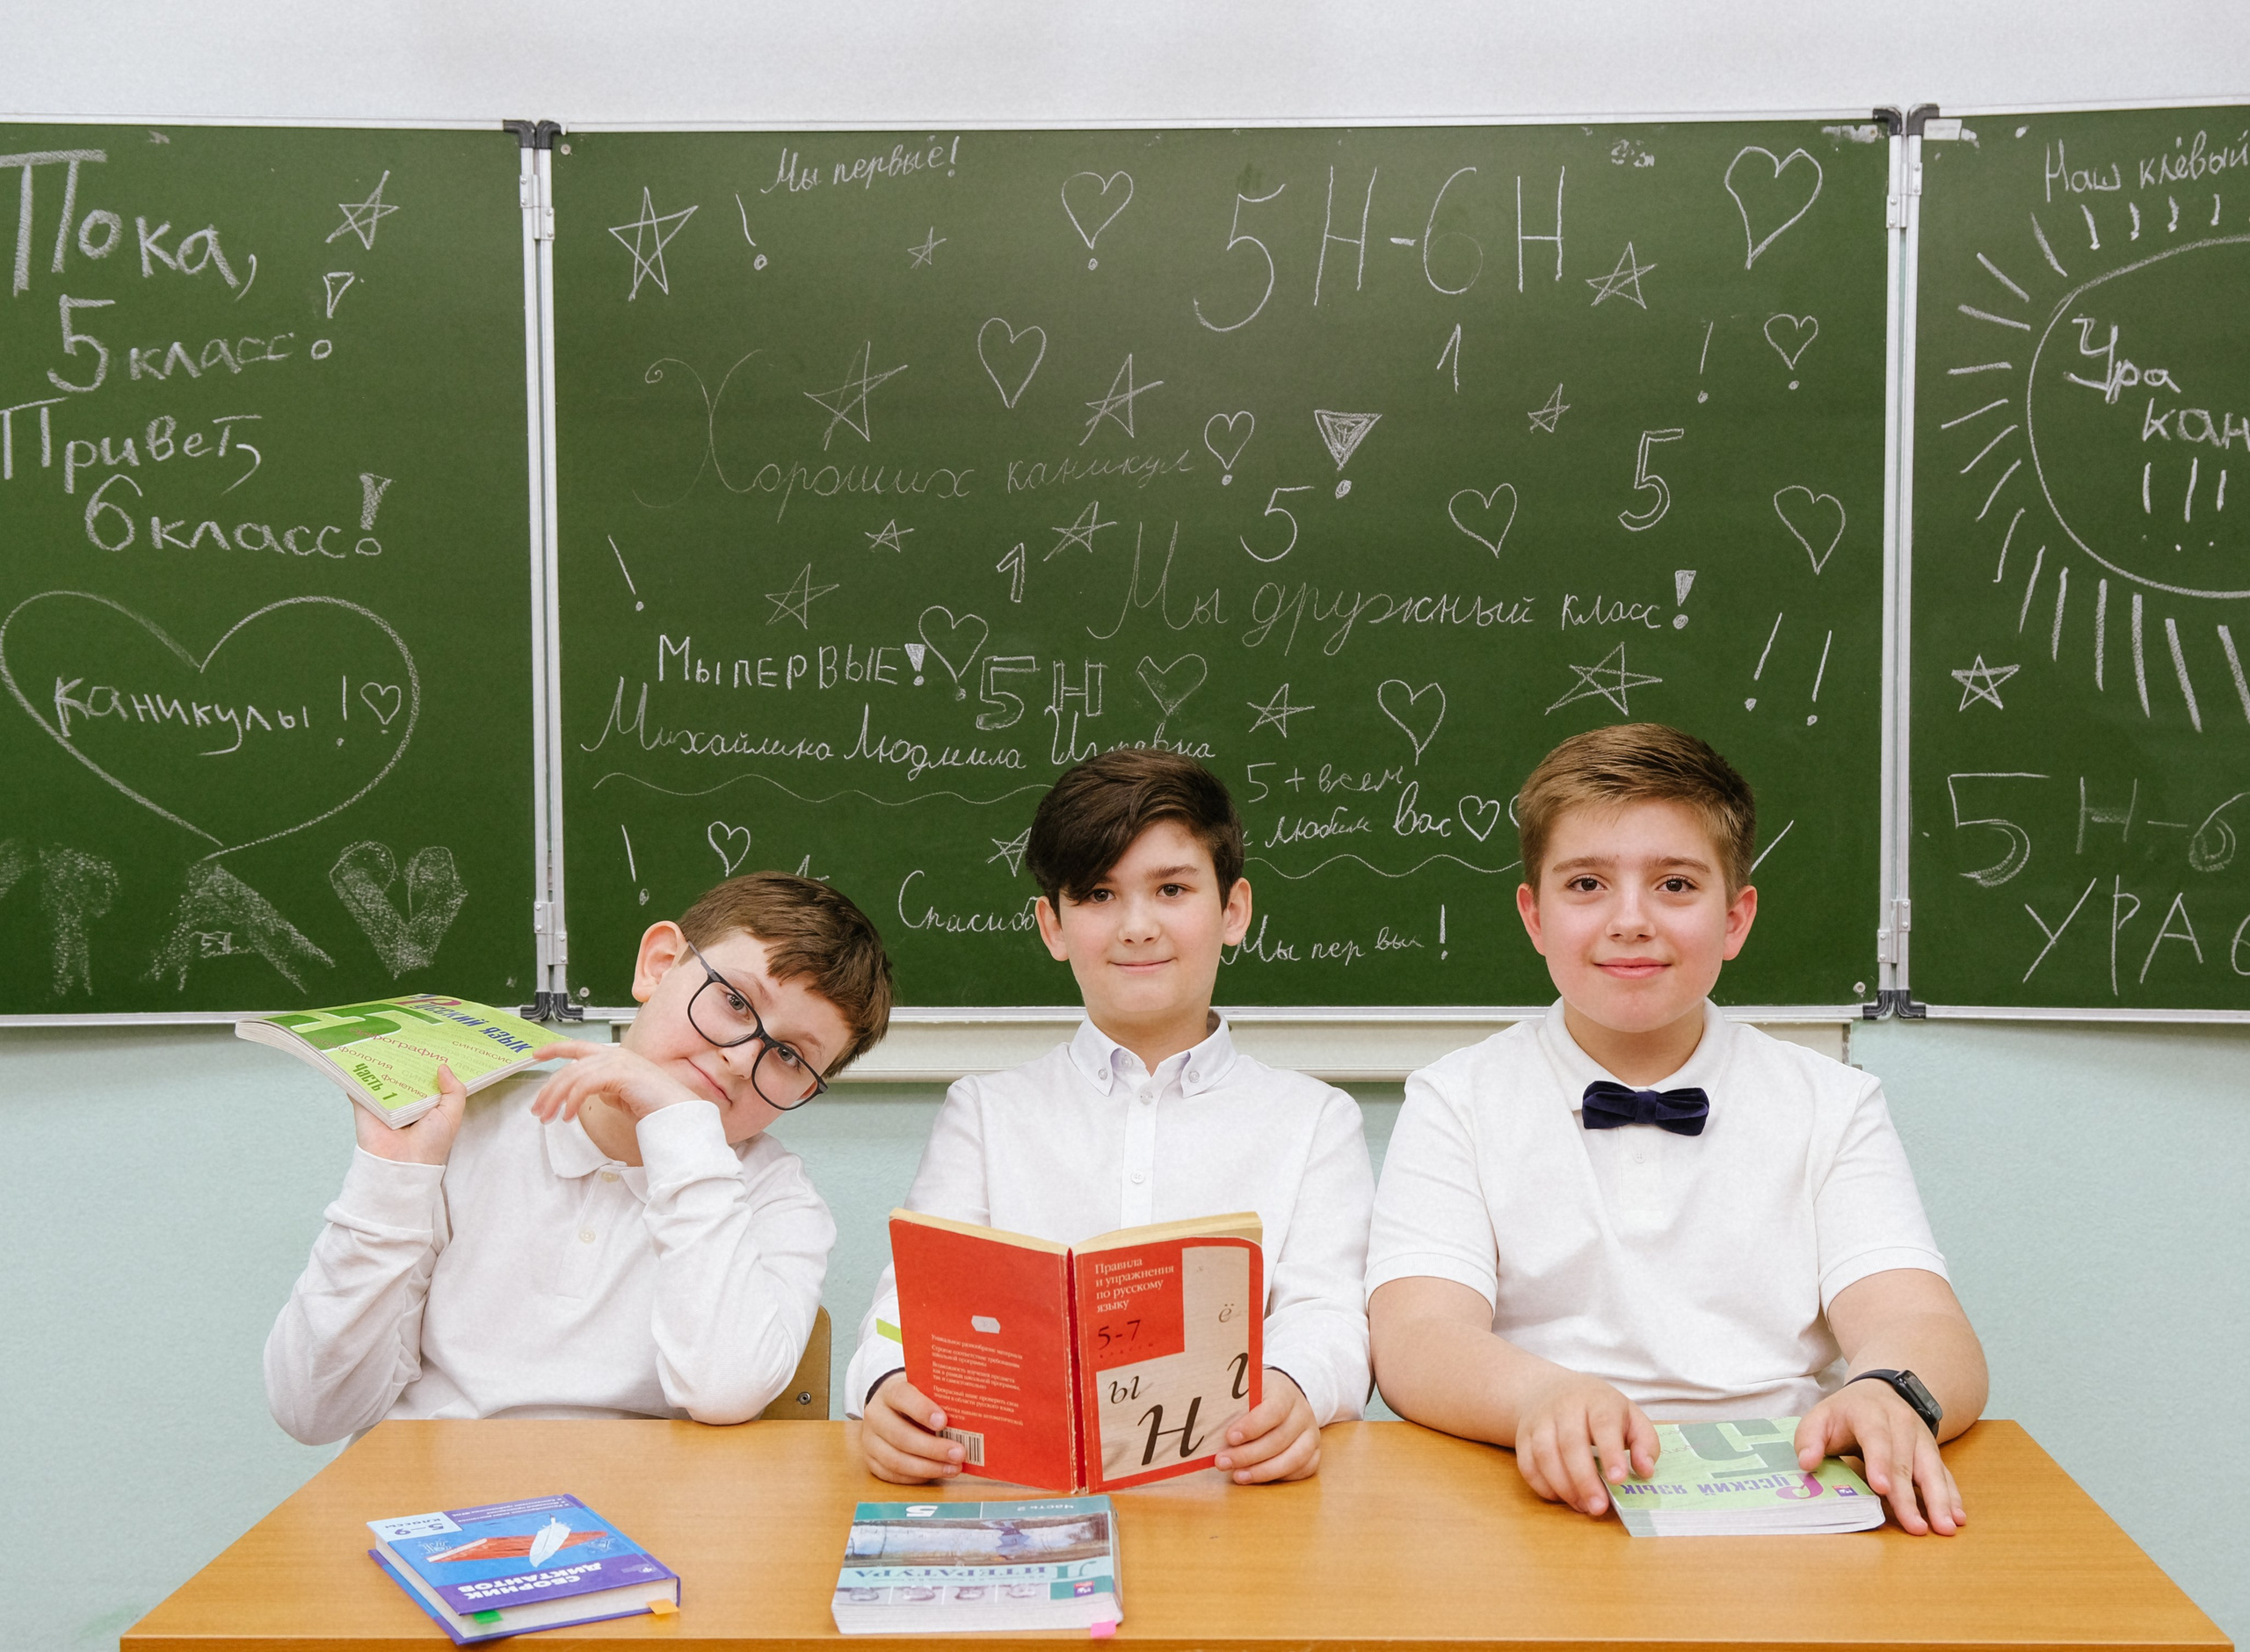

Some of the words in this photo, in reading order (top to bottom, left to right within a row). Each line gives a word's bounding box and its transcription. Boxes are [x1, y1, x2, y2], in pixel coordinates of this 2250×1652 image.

[760, 148, 822, 194] Мы
[2044, 137, 2123, 204] Наш
[0, 148, 258, 302] Пока,
[2063, 313, 2182, 405] Ура
[0, 396, 263, 495] Привет,
[1617, 427, 1685, 533] 5
[1239, 484, 1316, 563] 5
[1085, 519, 1230, 641] Мы
[1242, 582, 1536, 657] дружный
[843, 702, 1027, 782] Людмила
[312, 1037, 395, 1071] морфология
[349, 1026, 449, 1063] орфография
[452, 1040, 513, 1065] синтаксис
[478, 1026, 533, 1054] язык
[381, 1072, 429, 1100] фонетика
[1095, 1257, 1143, 1276] Правила
[1095, 1279, 1104, 1288] и
[1105, 1264, 1175, 1288] упражнения
[1096, 1289, 1112, 1301] по
[1113, 1279, 1165, 1300] русскому
[1096, 1299, 1130, 1314] языку
[1098, 1319, 1142, 1351] 5-7
[1620, 1483, 1688, 1496] язык
[457, 1561, 603, 1593] ДИКТАНТОВ
[467, 1574, 582, 1601] СБОРНИК
